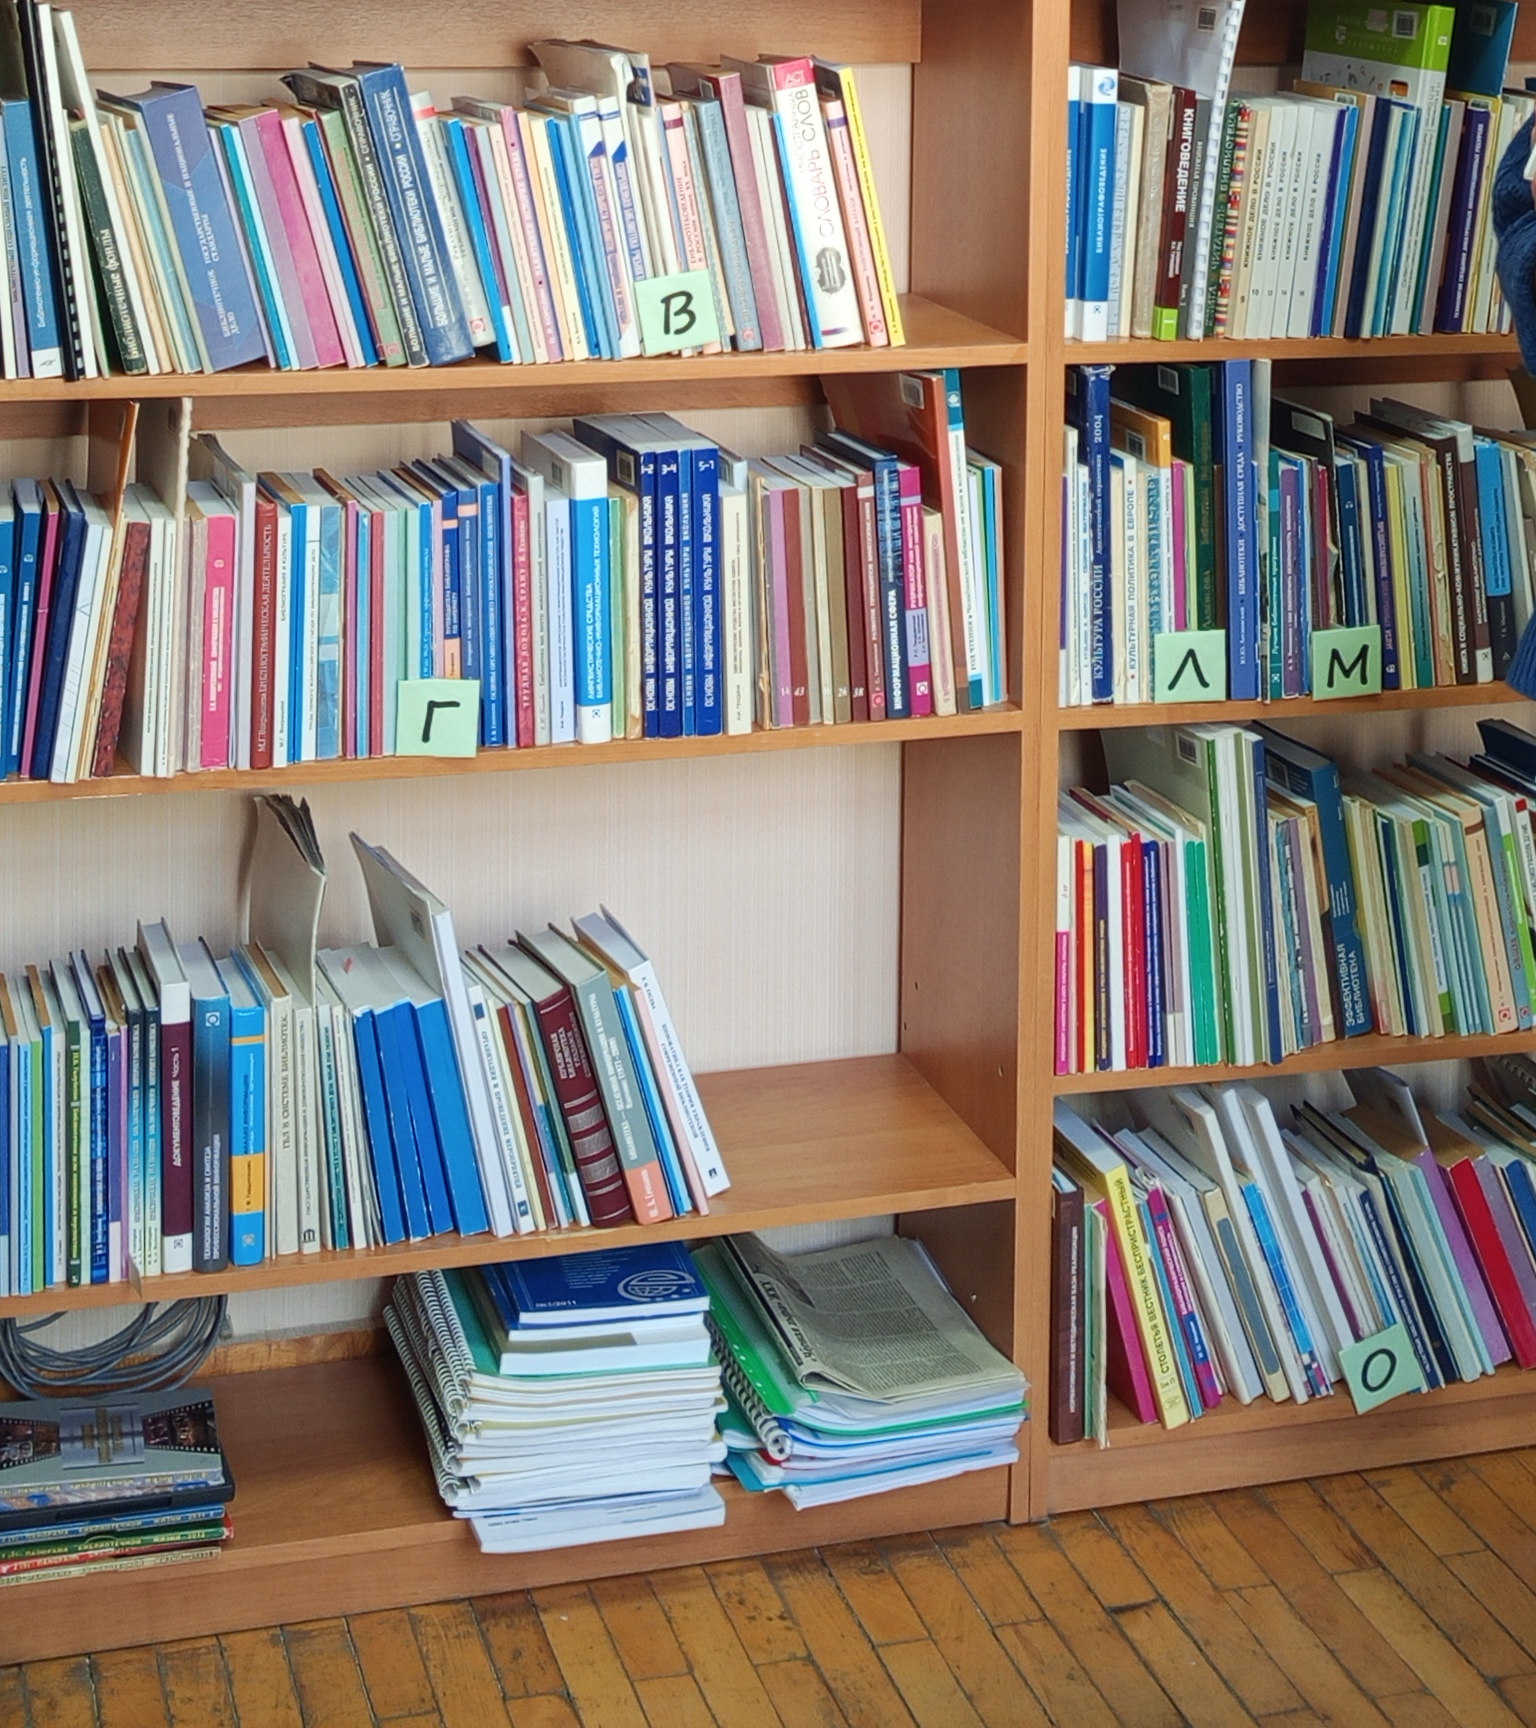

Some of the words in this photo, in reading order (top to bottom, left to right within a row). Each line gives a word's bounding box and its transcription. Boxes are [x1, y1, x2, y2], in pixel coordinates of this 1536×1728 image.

[380, 87, 402, 142] СПРАВОЧНИК
[793, 88, 816, 142] СЛОВ
[395, 153, 414, 188] РОССИИ
[1173, 107, 1194, 213] КНИГОВЕДЕНИЕ
[404, 189, 427, 243] БИБЛИОТЕКИ
[804, 147, 835, 237] СЛОВАРЬ
[1255, 217, 1267, 261] КНИЖНОЕ
[1261, 190, 1271, 215] ДЕЛО
[1266, 141, 1277, 178] РОССИИ
[98, 227, 121, 271] фонды
[417, 243, 435, 275] МАЛЫЕ
[425, 275, 437, 283] И
[107, 270, 140, 360] Библиотечные
[428, 285, 449, 326] БОЛЬШИЕ
[660, 290, 697, 336] В
[1094, 414, 1103, 443] 2004
[1234, 383, 1245, 442] РУКОВОДСТВО
[1235, 452, 1246, 478] СРЕДА
[701, 493, 713, 542] ШКОЛЬНИКА
[1126, 489, 1135, 529] ЕВРОПЕ
[1236, 480, 1246, 531] ДОСТУПНАЯ
[261, 523, 272, 592] ДЕЯТЕЛЬНОСТЬ
[702, 546, 713, 590] КУЛЬТУРЫ
[1127, 544, 1136, 599] ПОЛИТИКА
[1237, 539, 1247, 595] БИБЛИОТЕКИ
[887, 588, 898, 619] СФЕРА
[1091, 564, 1103, 614] РОССИИ
[258, 593, 270, 691] БИБЛИОГРАФИЧЕСКАЯ
[703, 594, 714, 669] ИНФОРМАЦИОННОЙ
[1091, 617, 1104, 679] КУЛЬТУРА
[1127, 604, 1136, 668] КУЛЬТУРНАЯ
[703, 673, 715, 706] ОСНОВЫ
[888, 619, 902, 710] ИНФОРМАЦИОННАЯ
[1168, 648, 1210, 691] Л
[1327, 644, 1369, 689] М
[423, 700, 460, 743] Г
[1336, 943, 1355, 1027] ЭФФЕКТИВНАЯ
[1346, 950, 1366, 1023] БИБЛИОТЕКА
[171, 1054, 180, 1077] Часть
[171, 1080, 181, 1166] ДОКУМЕНТОВЕДЕНИЕ
